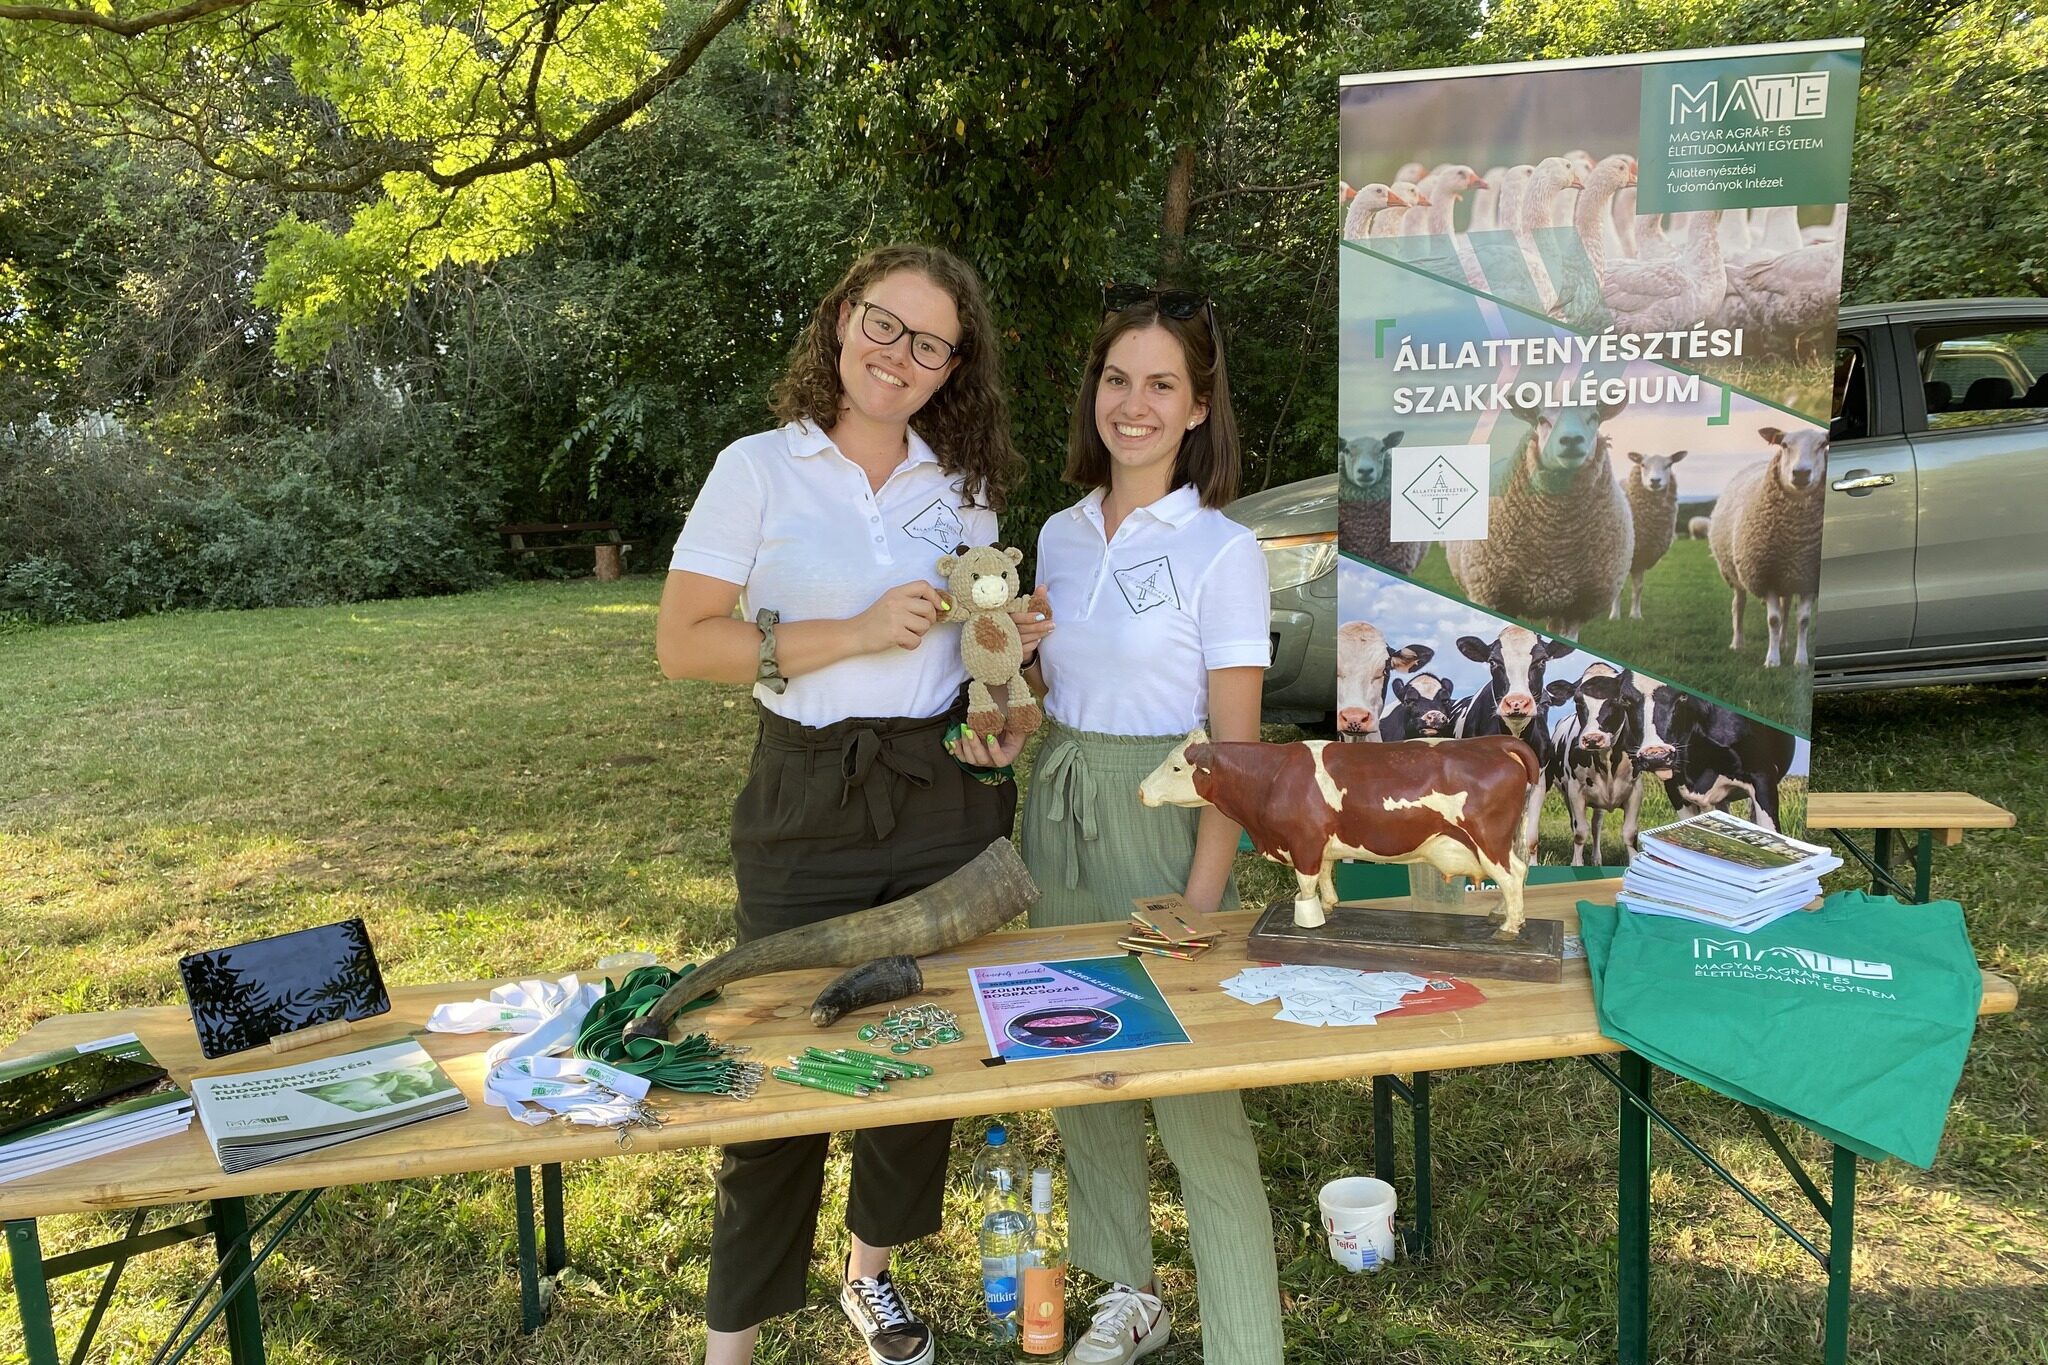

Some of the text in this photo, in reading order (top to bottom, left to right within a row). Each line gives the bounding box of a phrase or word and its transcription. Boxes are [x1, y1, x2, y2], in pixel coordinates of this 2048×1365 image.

[1669, 71, 1830, 125] MATE
[1669, 124, 1792, 143] MAGYAR AGRÁR- ÉS
[1668, 138, 1824, 157] ÉLETTUDOMÁNYI EGYETEM
[1667, 163, 1757, 179] Állattenyésztési
[1667, 177, 1784, 194] Tudományok Intézet
[1393, 320, 1744, 372] ÁLLATTENYÉSZTÉSI
[1393, 370, 1700, 415] SZAKKOLLÉGIUM
[1694, 962, 1763, 973] MAGYAR
[1833, 976, 1850, 985] ÉS
[984, 986, 1080, 999] BOGRÁCSOZÁS
[1823, 983, 1896, 1001] EGYETEM
[210, 1060, 373, 1090] ÁLLATTENYÉSZTÉSI
[211, 1074, 342, 1096] TUDOMÁNYOK
[215, 1090, 279, 1101] INTÉZET
